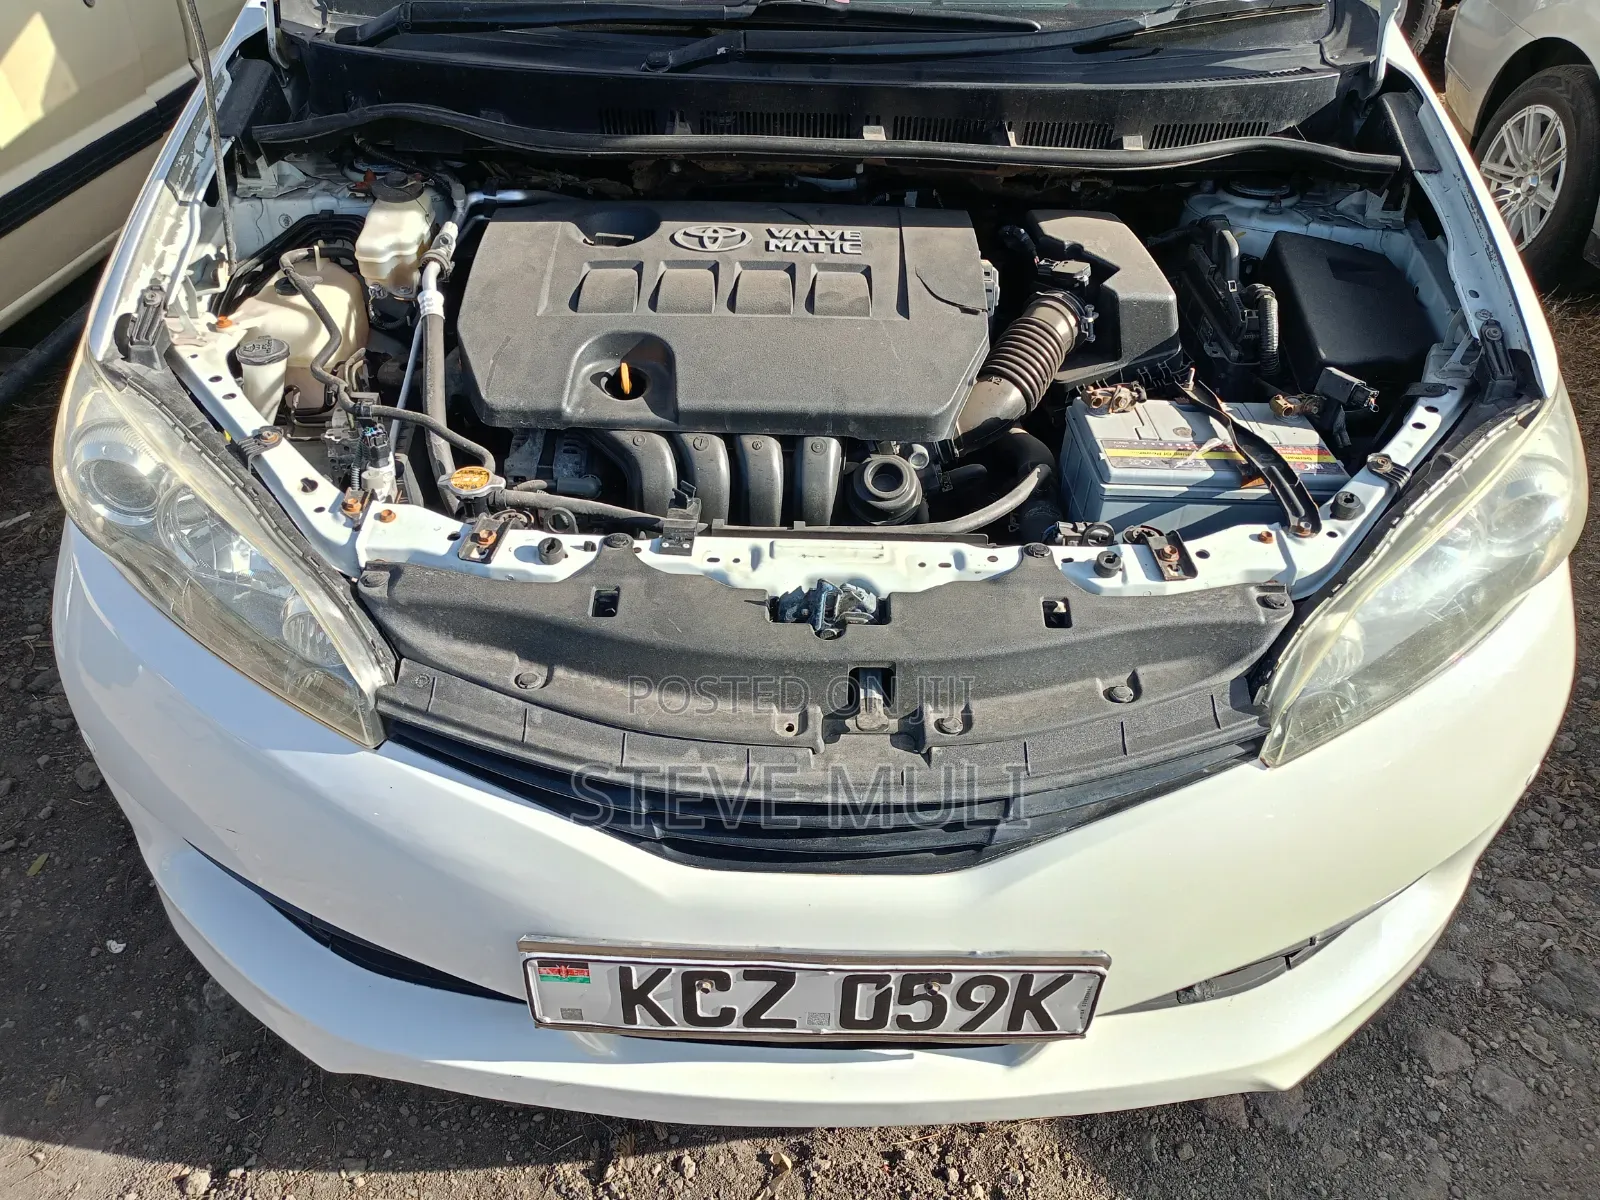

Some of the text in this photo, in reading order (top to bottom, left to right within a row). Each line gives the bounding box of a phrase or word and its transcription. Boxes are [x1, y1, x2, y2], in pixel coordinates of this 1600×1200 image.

[765, 227, 862, 242] VALVE
[765, 239, 862, 255] MATIC
[618, 965, 798, 1029] KCZ
[839, 972, 1075, 1032] 059K
